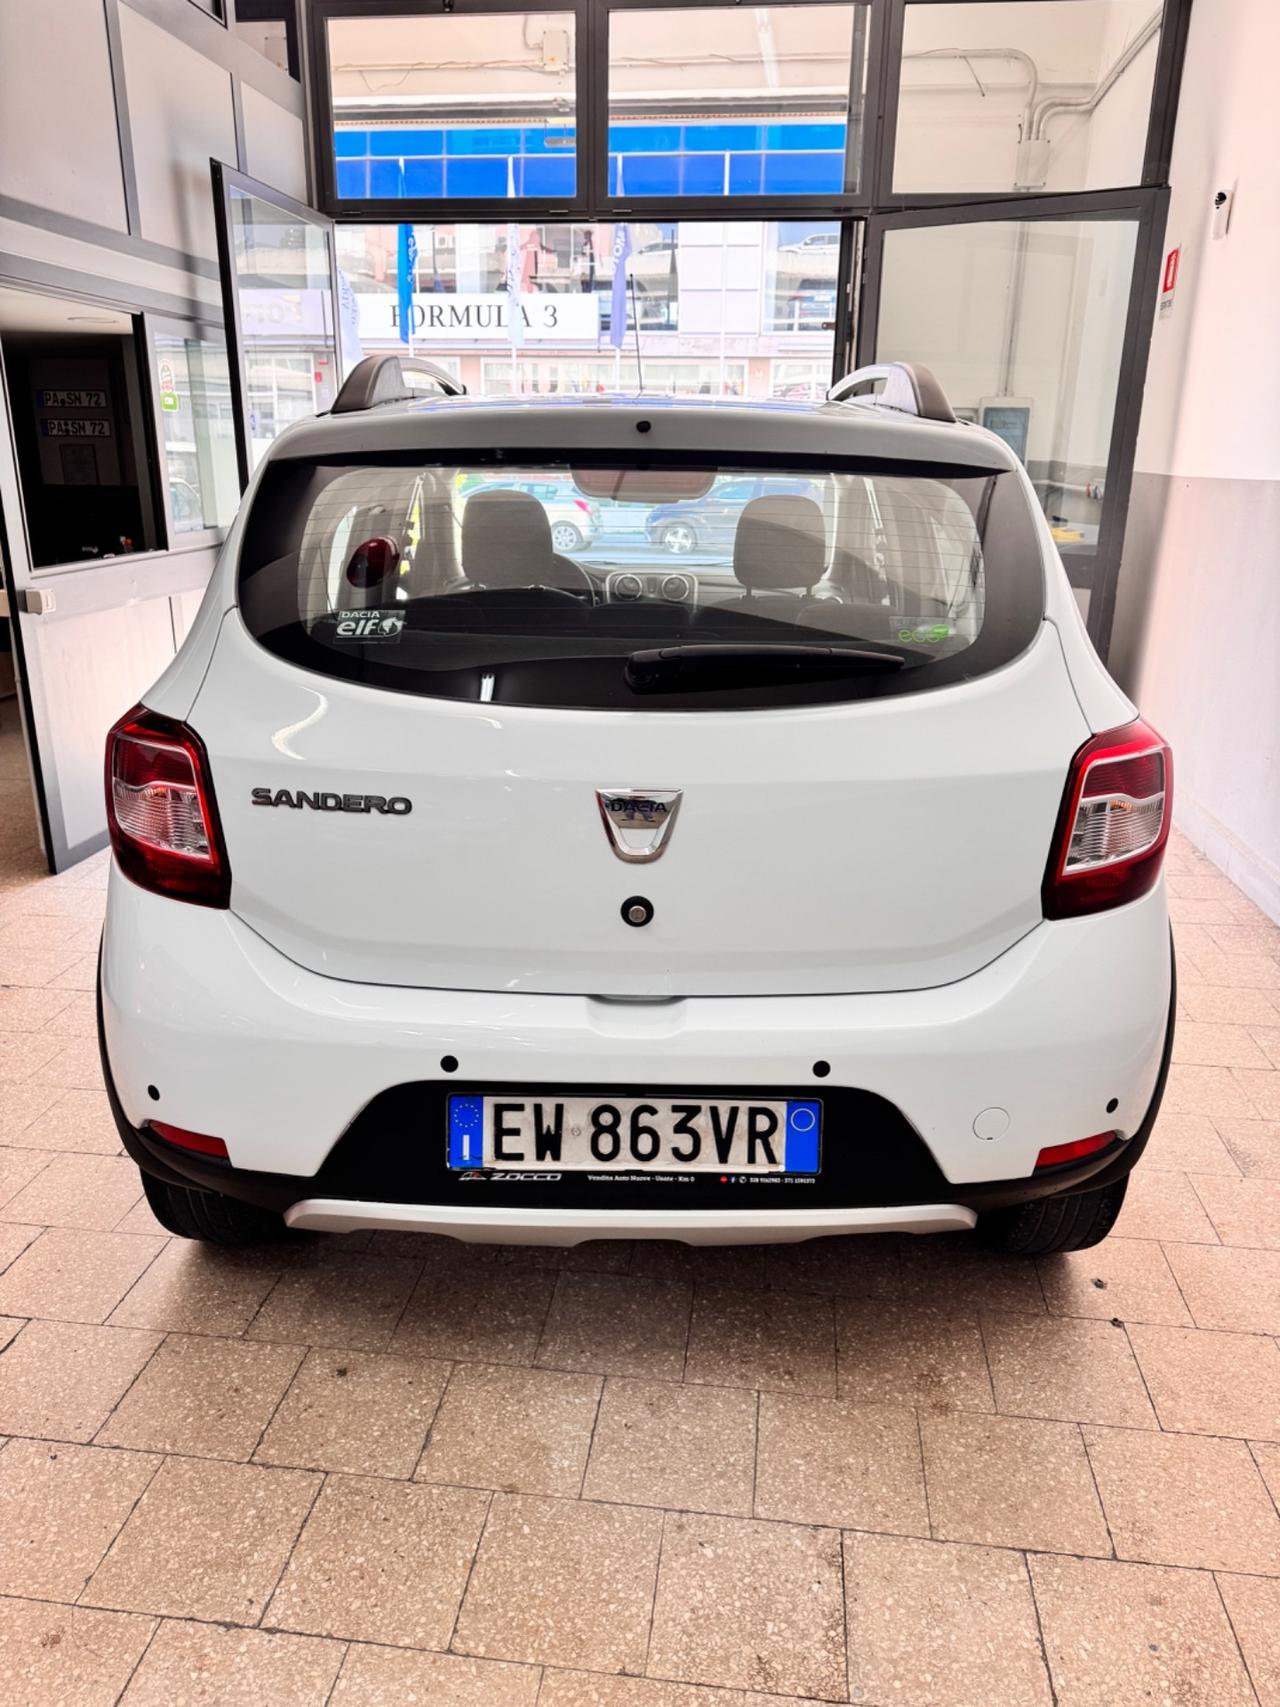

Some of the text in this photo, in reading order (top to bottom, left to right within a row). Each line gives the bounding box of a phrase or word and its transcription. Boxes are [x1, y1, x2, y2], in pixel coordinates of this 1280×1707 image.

[544, 304, 558, 328] 3
[44, 392, 101, 406] PA SN 72
[48, 421, 105, 435] PA SN 72
[337, 619, 379, 635] elf
[251, 787, 413, 816] SANDERO
[494, 1103, 564, 1161] EW
[490, 1173, 562, 1181] ZOCCO
